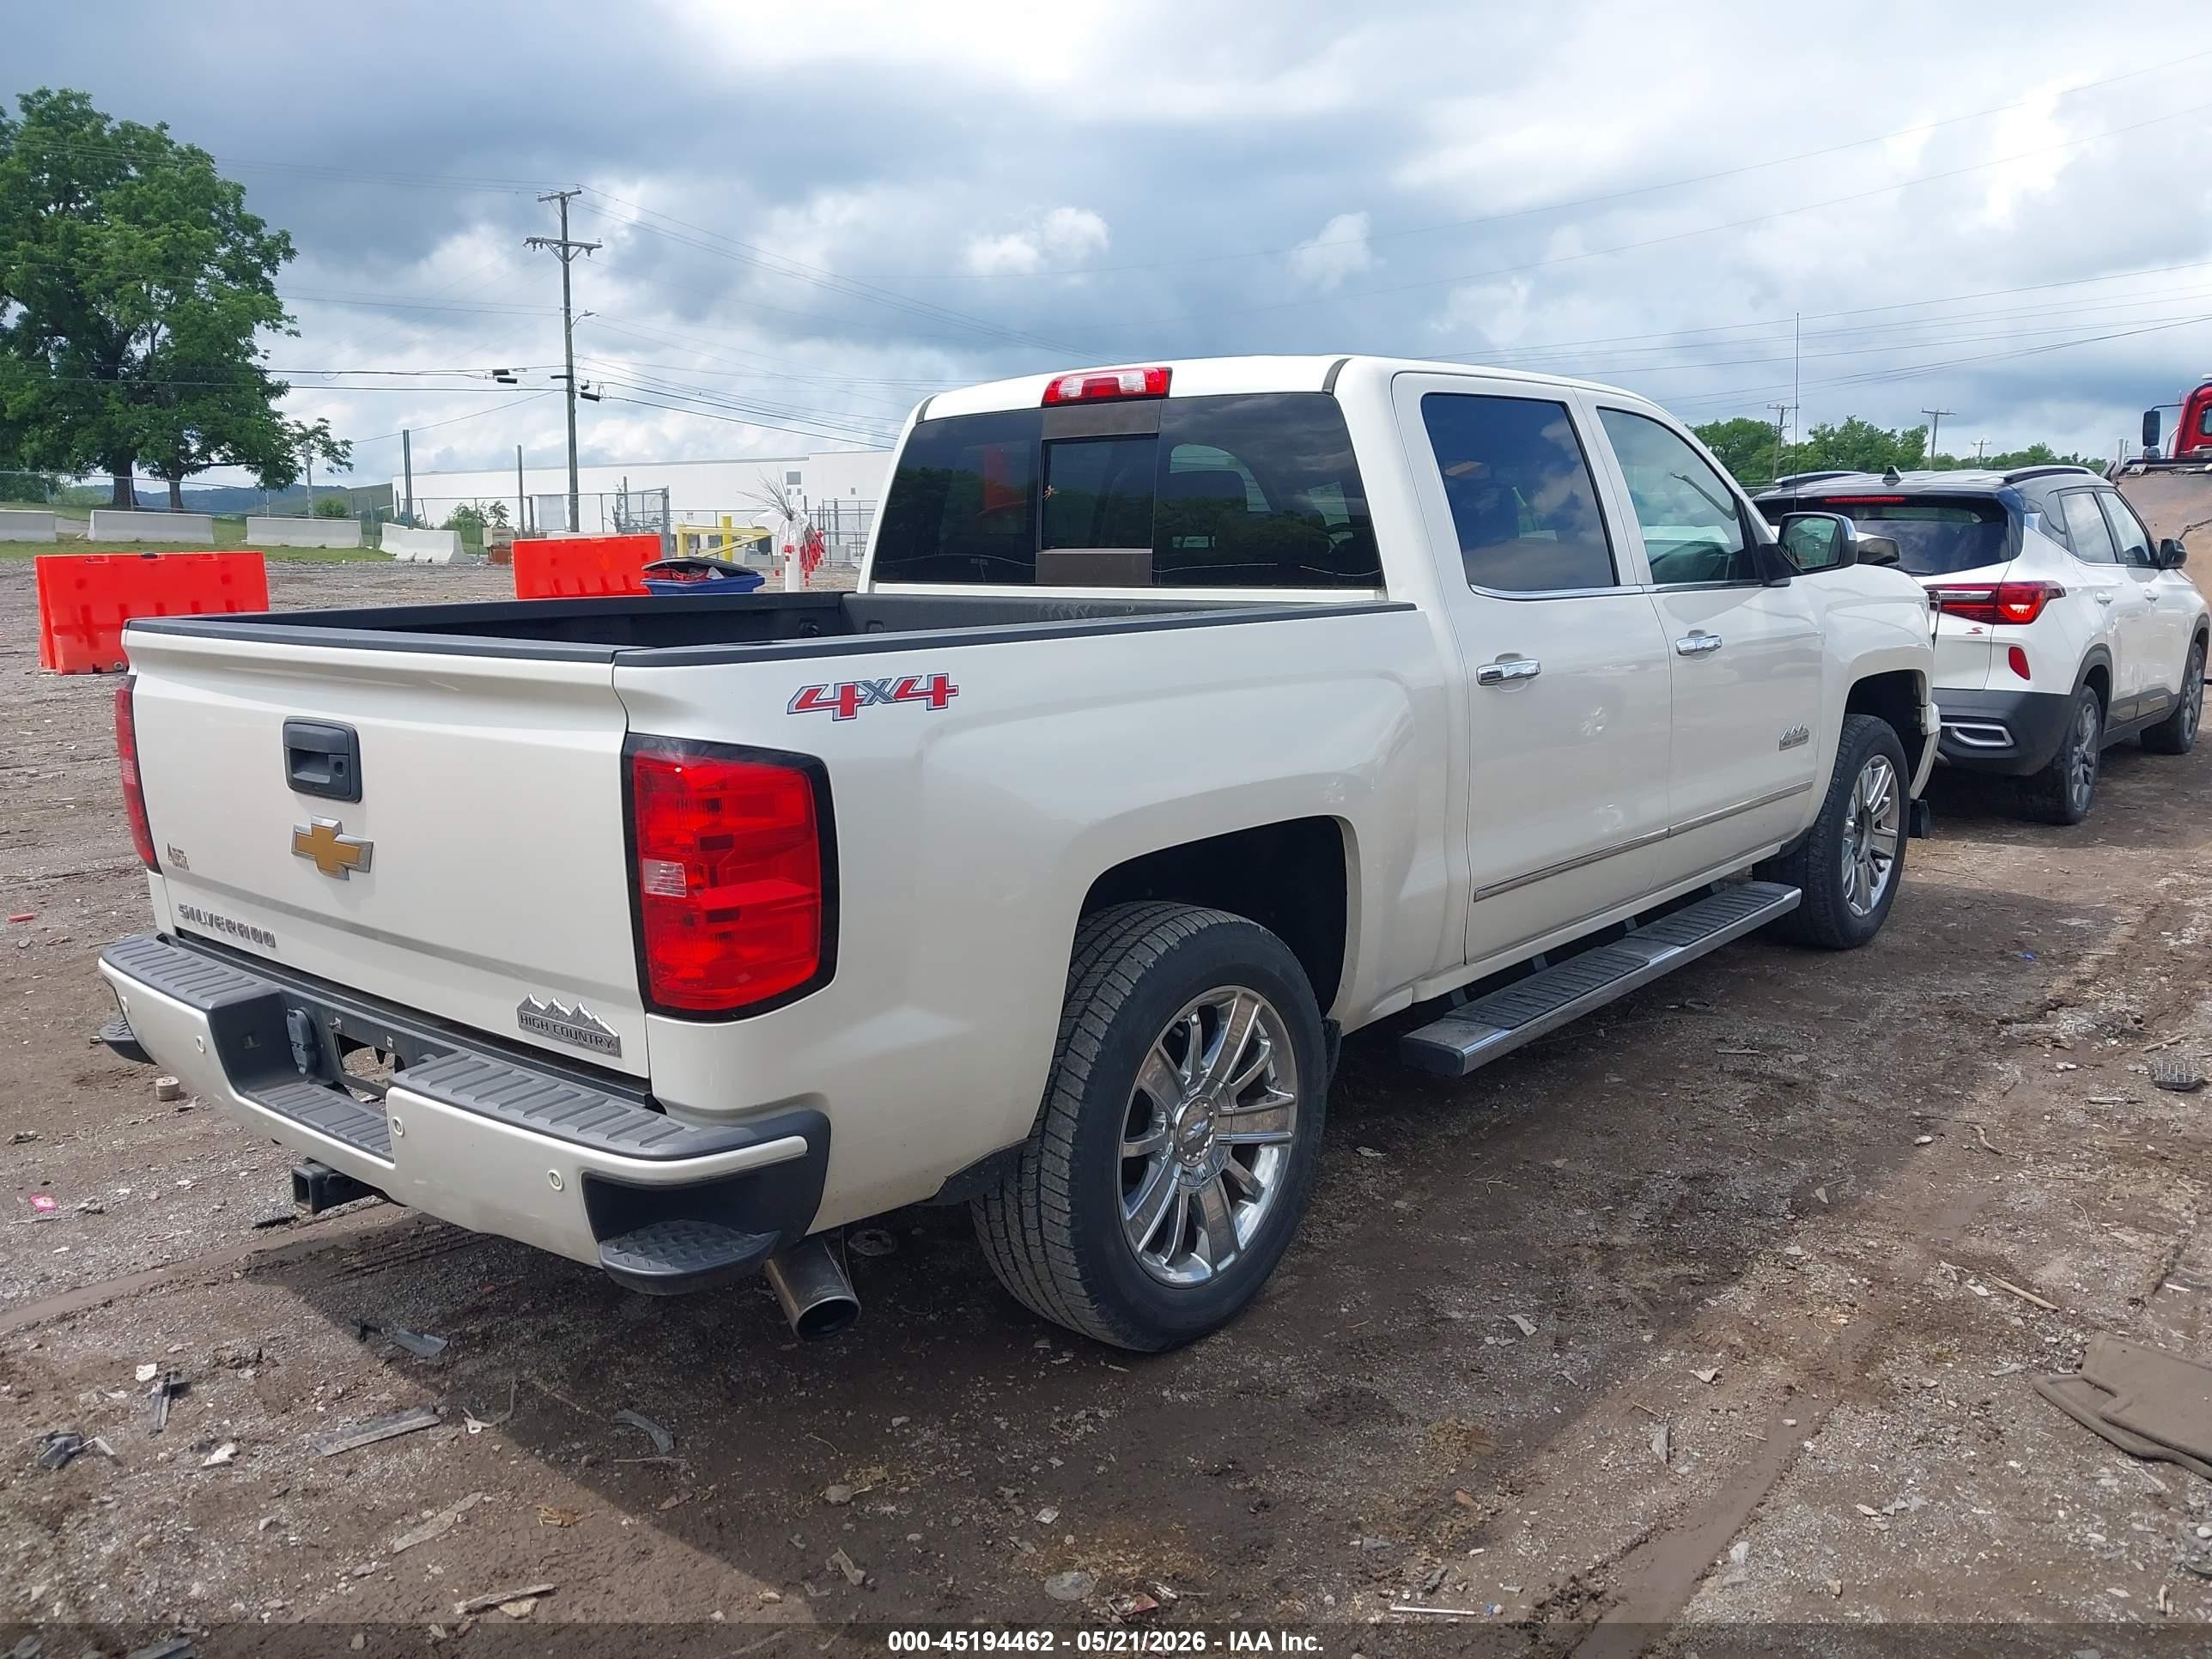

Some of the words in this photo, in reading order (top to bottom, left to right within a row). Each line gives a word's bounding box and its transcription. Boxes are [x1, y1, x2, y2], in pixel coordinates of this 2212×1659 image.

[178, 903, 276, 948] SILVERADO
[520, 1014, 549, 1031] HIGH
[553, 1024, 613, 1048] COUNTRY
